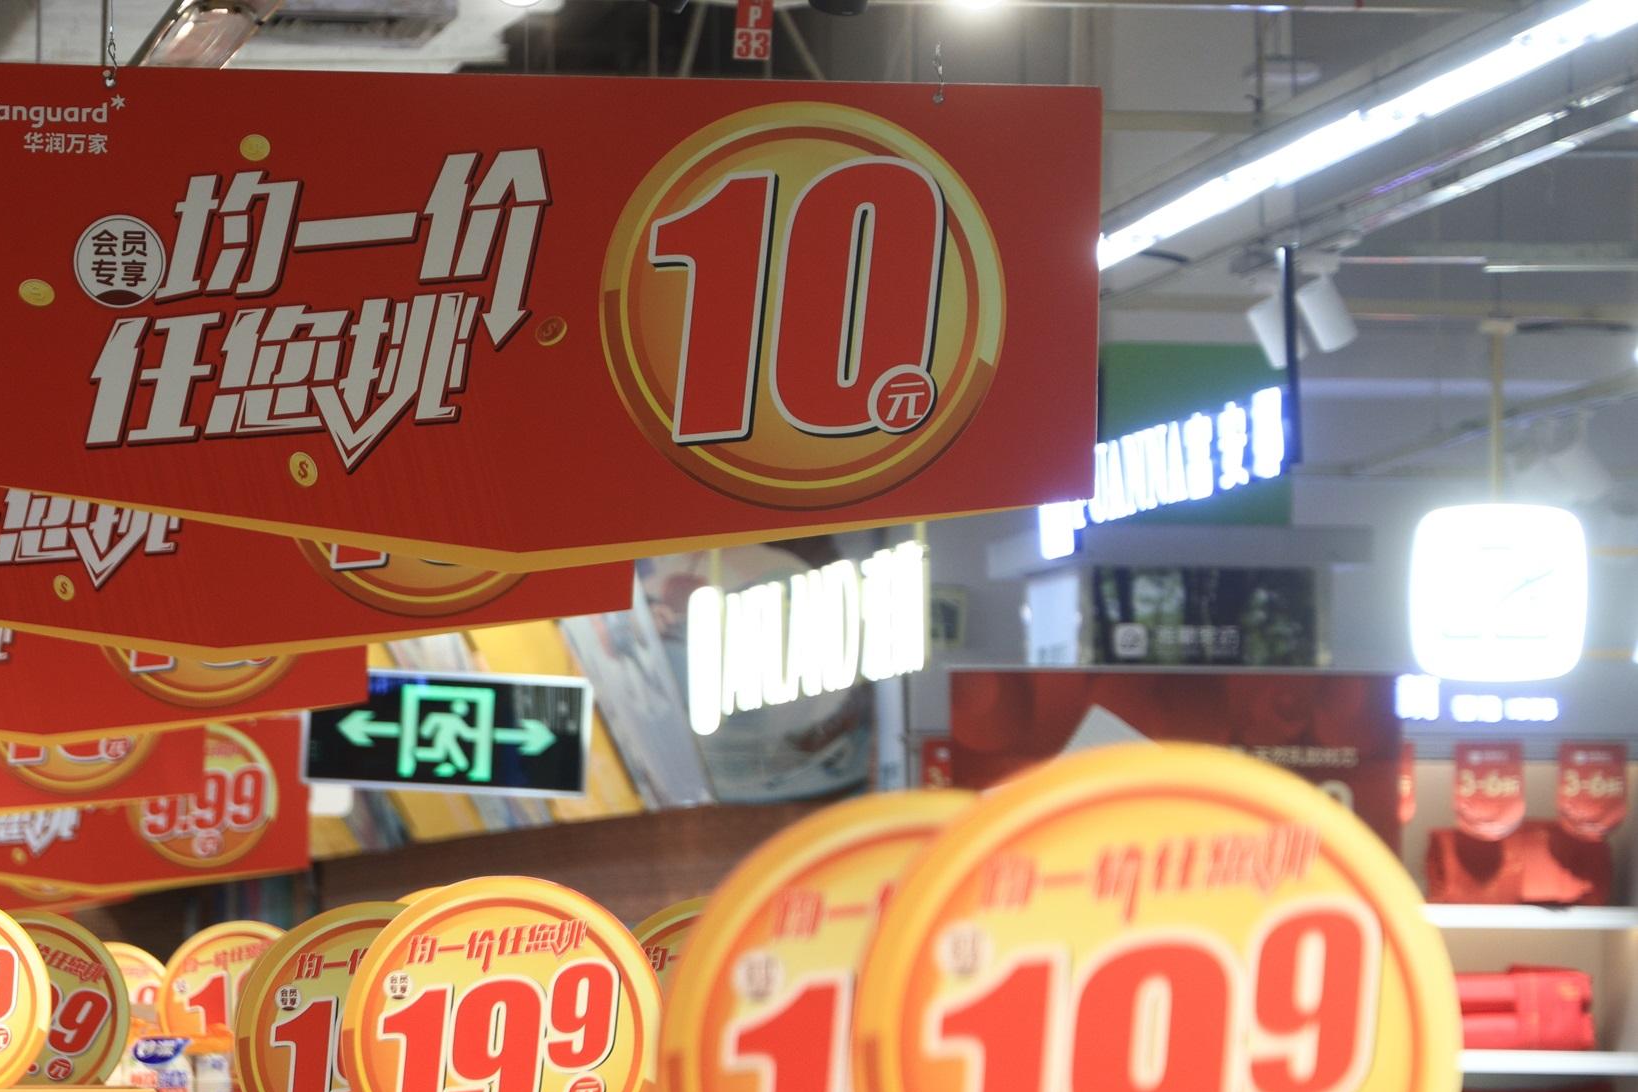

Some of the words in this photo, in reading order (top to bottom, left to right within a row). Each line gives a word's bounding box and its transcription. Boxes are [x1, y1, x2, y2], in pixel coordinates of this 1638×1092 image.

[737, 31, 770, 58] 33
[24, 132, 109, 154] 华润万家
[91, 229, 148, 257] 会员
[156, 147, 553, 348] 均一价
[91, 260, 147, 287] 专享
[648, 155, 947, 446] 10
[885, 382, 929, 426] 元
[85, 291, 485, 472] 任您挑
[406, 919, 590, 973] 均一价任您挑
